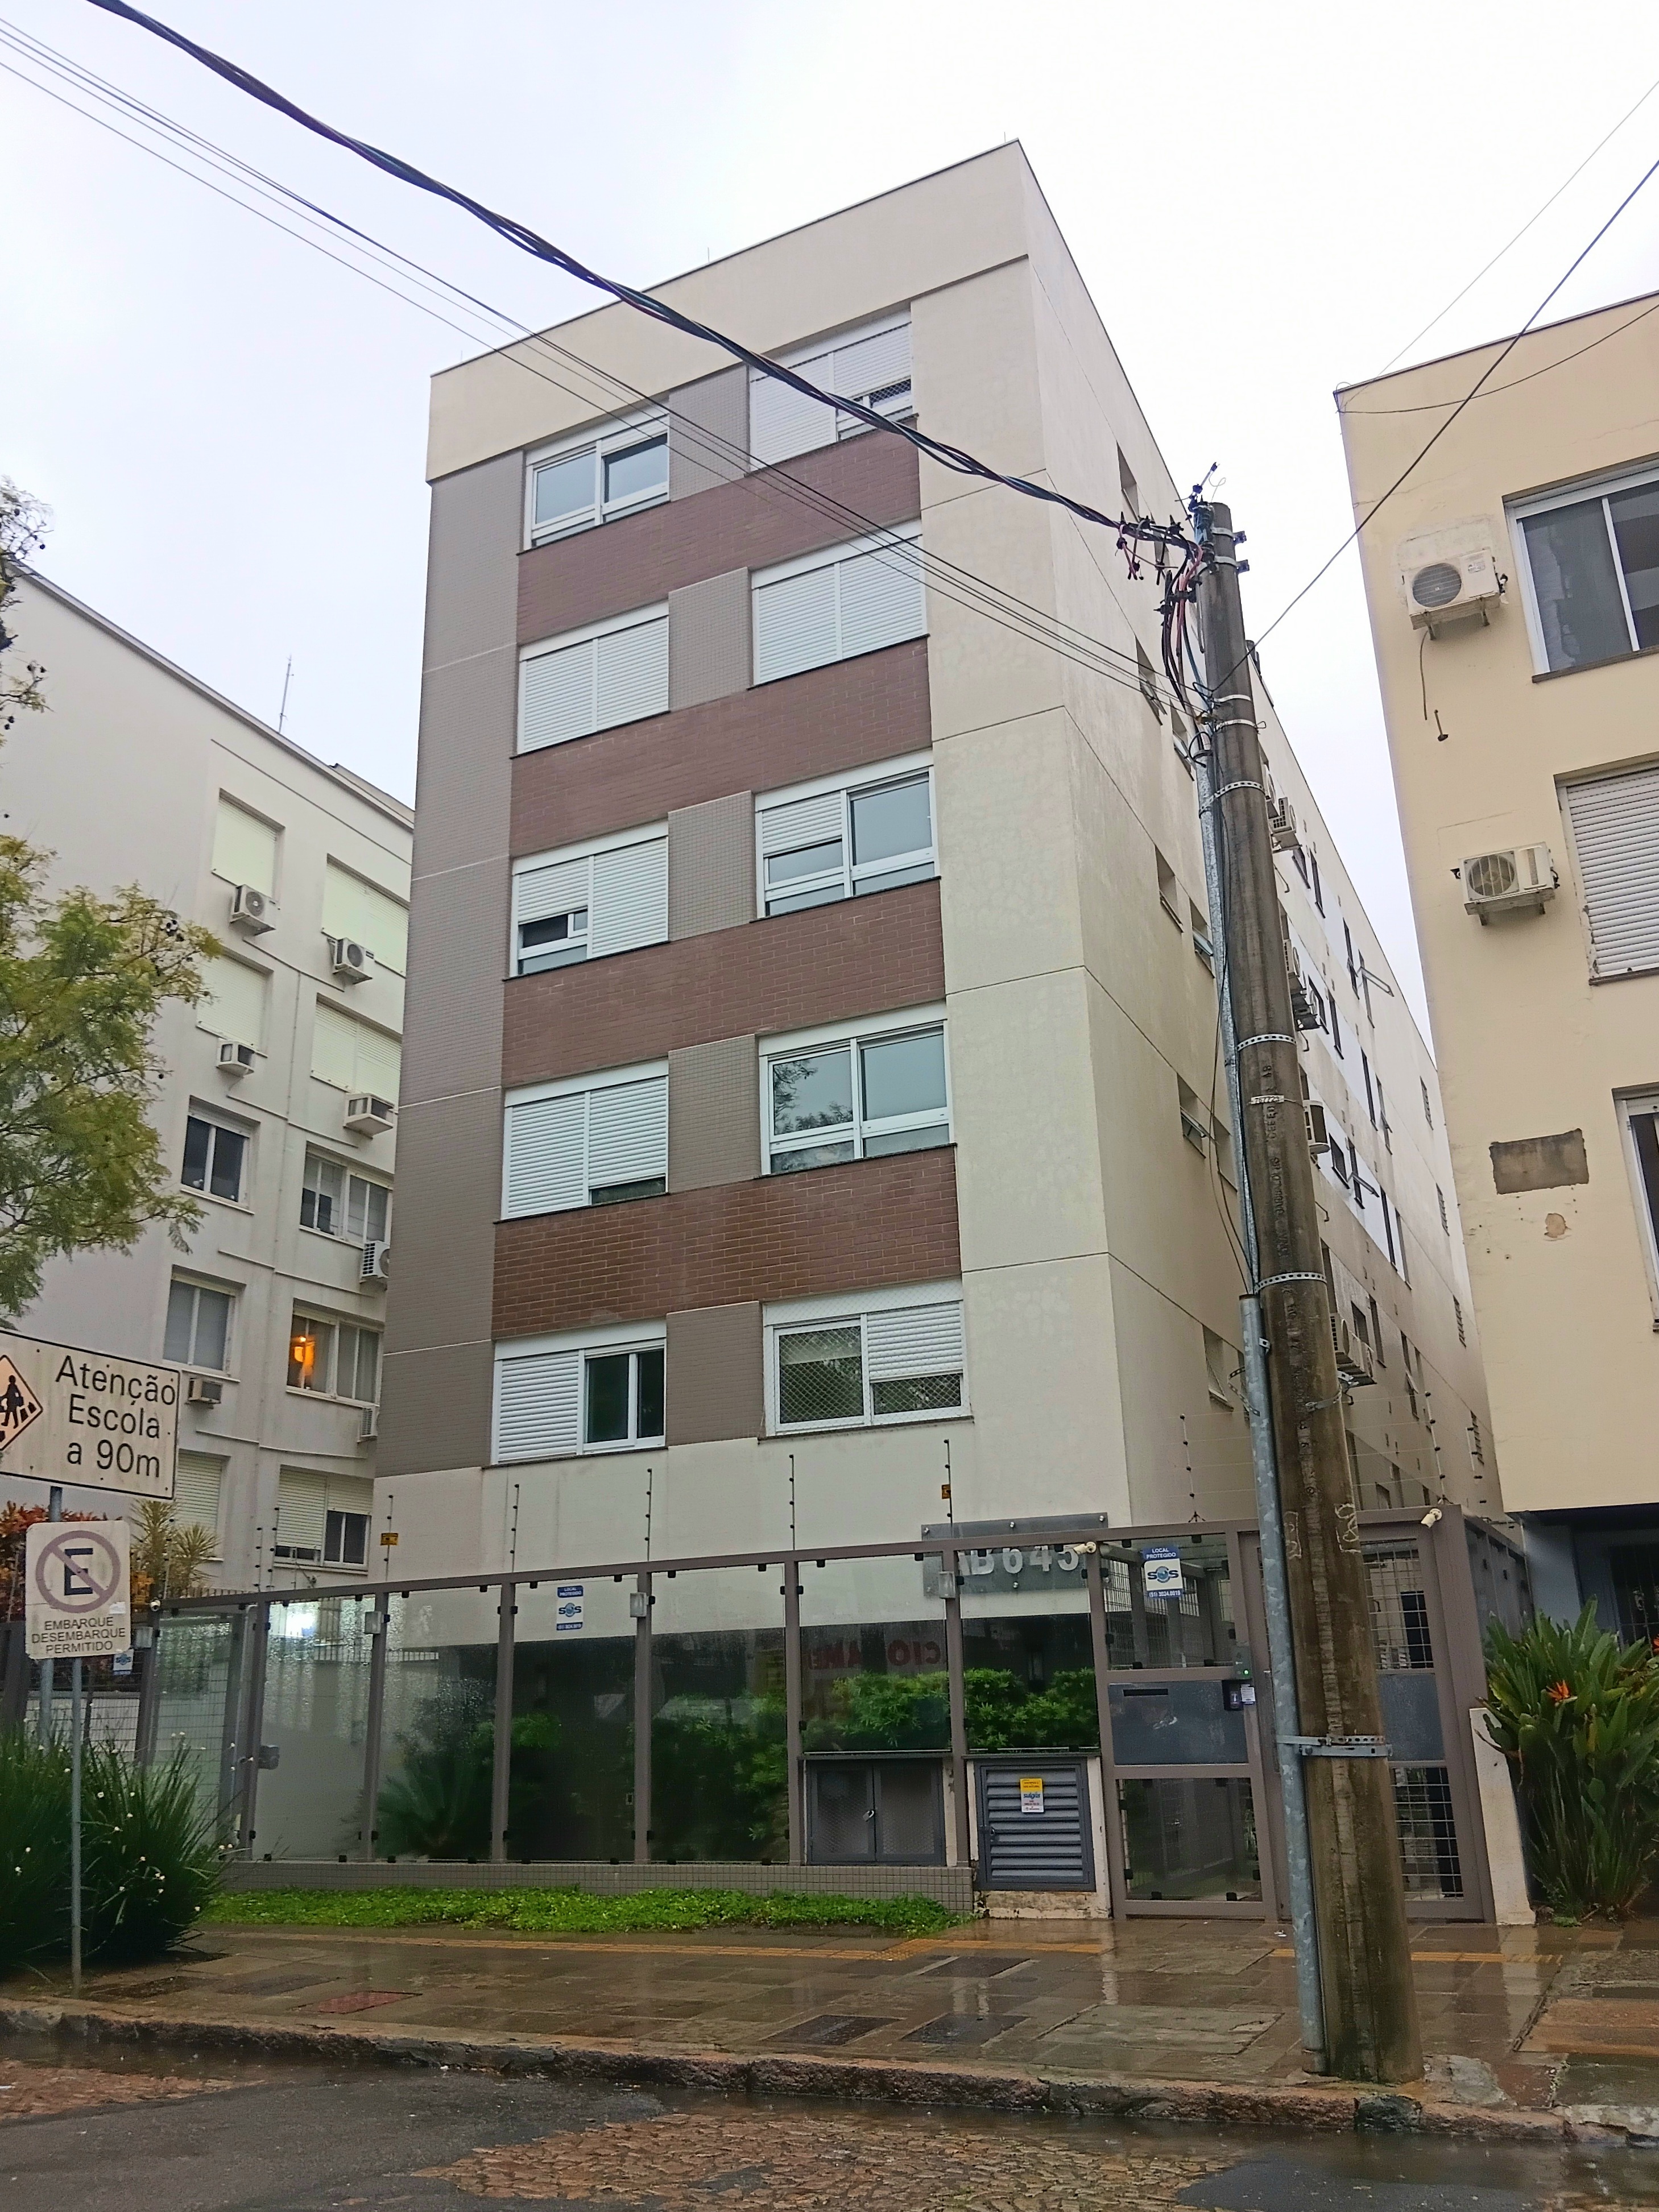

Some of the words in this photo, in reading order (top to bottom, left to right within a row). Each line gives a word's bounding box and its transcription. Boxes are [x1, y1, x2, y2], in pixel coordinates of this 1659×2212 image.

[55, 1355, 176, 1405] Atenção
[69, 1393, 160, 1439] Escola
[67, 1442, 82, 1465] a
[97, 1439, 160, 1478] 90m
[1002, 1544, 1079, 1574] 645
[64, 1548, 93, 1596] E
[1147, 1565, 1179, 1583] SOS
[558, 1602, 582, 1617] SOS
[31, 1627, 126, 1644] DESEMBARQUE
[44, 1617, 114, 1631] EMBARQUE
[45, 1641, 113, 1654] PERMITIDO
